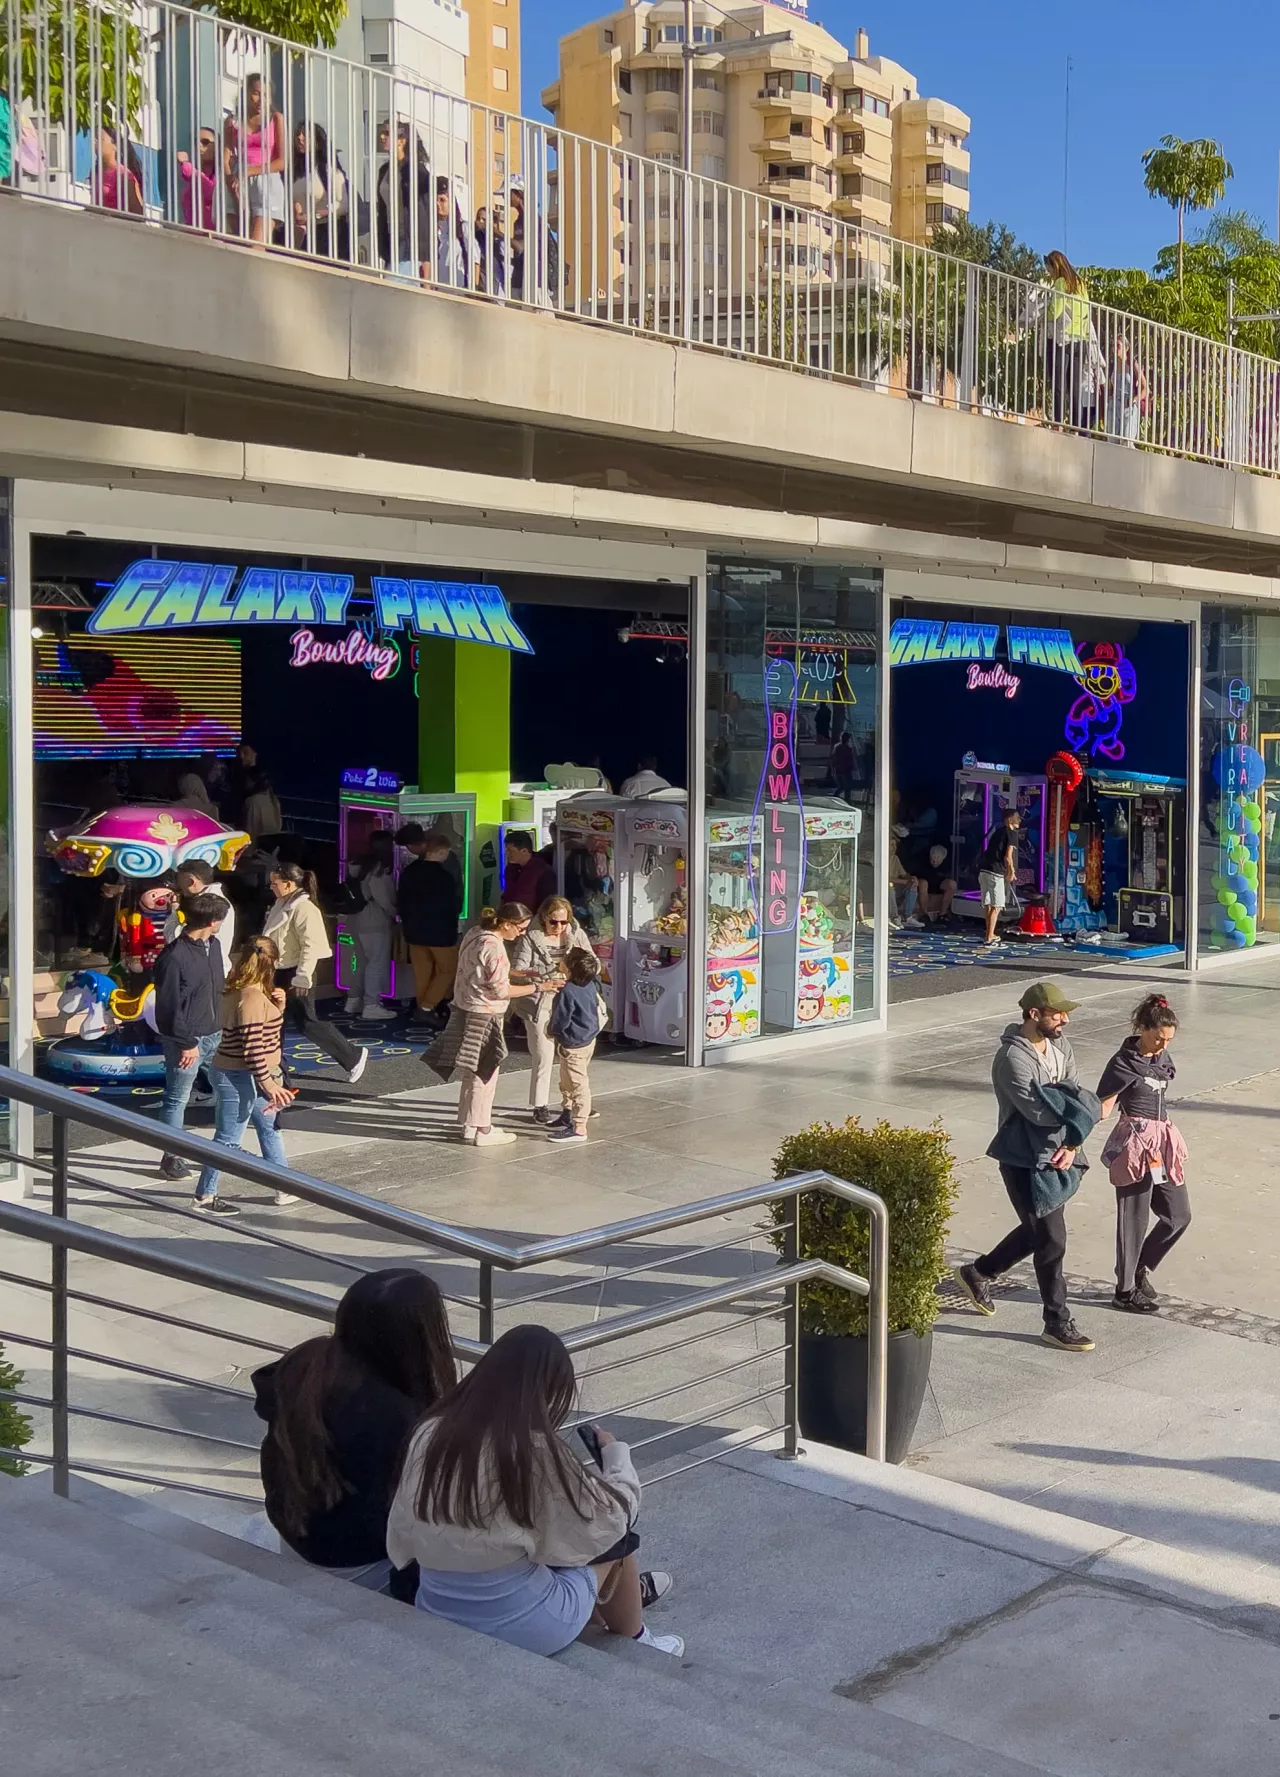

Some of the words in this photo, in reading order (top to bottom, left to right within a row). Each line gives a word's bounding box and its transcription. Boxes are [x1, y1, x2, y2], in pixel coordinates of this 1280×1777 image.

[86, 559, 354, 635] GALAXY
[371, 576, 536, 655] PARK
[290, 629, 399, 680] Bowling
[890, 618, 999, 668] GALAXY
[1006, 624, 1086, 677] PARK
[967, 663, 1021, 698] Bowling
[364, 767, 378, 787] 2
[378, 776, 397, 788] Win
[1227, 723, 1237, 876] VIRTUAL
[1239, 723, 1248, 874] REALITY
[768, 712, 791, 925] BOWLING
